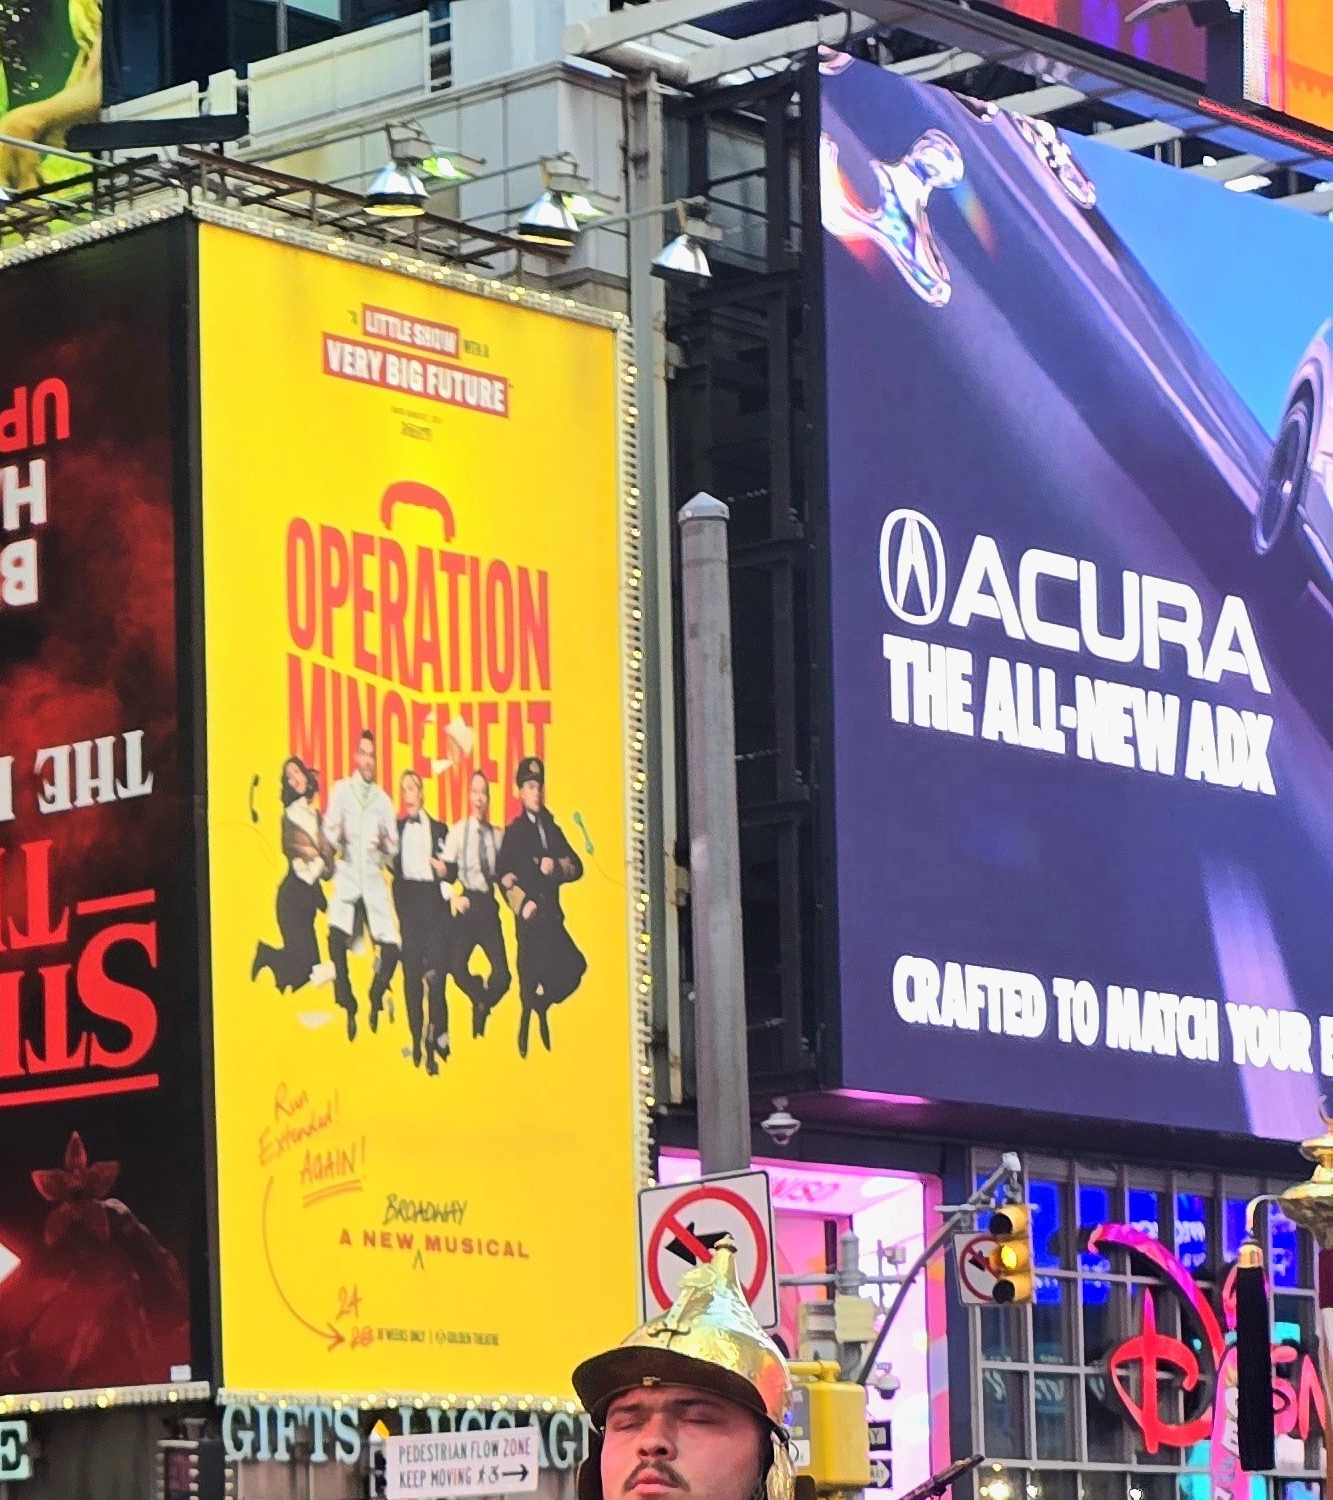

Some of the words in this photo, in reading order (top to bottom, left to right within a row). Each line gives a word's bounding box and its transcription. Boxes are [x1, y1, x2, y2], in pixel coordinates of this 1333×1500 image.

[365, 309, 412, 343] LITTLE
[413, 322, 458, 355] SHOW
[326, 338, 384, 382] VERY
[385, 352, 424, 393] BIG
[426, 363, 506, 413] FUTURE
[286, 515, 552, 694] OPERATION
[948, 535, 1272, 694] ACURA
[883, 634, 974, 737] THE
[981, 657, 1181, 776] ALL-NEW
[1185, 700, 1277, 796] ADX
[34, 729, 155, 817] THE
[892, 955, 1047, 1039] CRAFTED
[1053, 977, 1100, 1046] TO
[1106, 985, 1220, 1062] MATCH
[1225, 1002, 1313, 1075] YOUR
[383, 1193, 467, 1226] BROADWAY
[339, 1228, 352, 1246] A
[363, 1229, 414, 1250] NEW
[424, 1234, 530, 1259] MUSICAL
[222, 1404, 361, 1464] GIFTS
[399, 1441, 468, 1464] PEDESTRIAN
[470, 1439, 500, 1460] FLOW
[503, 1437, 531, 1457] ZONE
[399, 1469, 426, 1489] KEEP
[430, 1467, 472, 1486] MOVING
